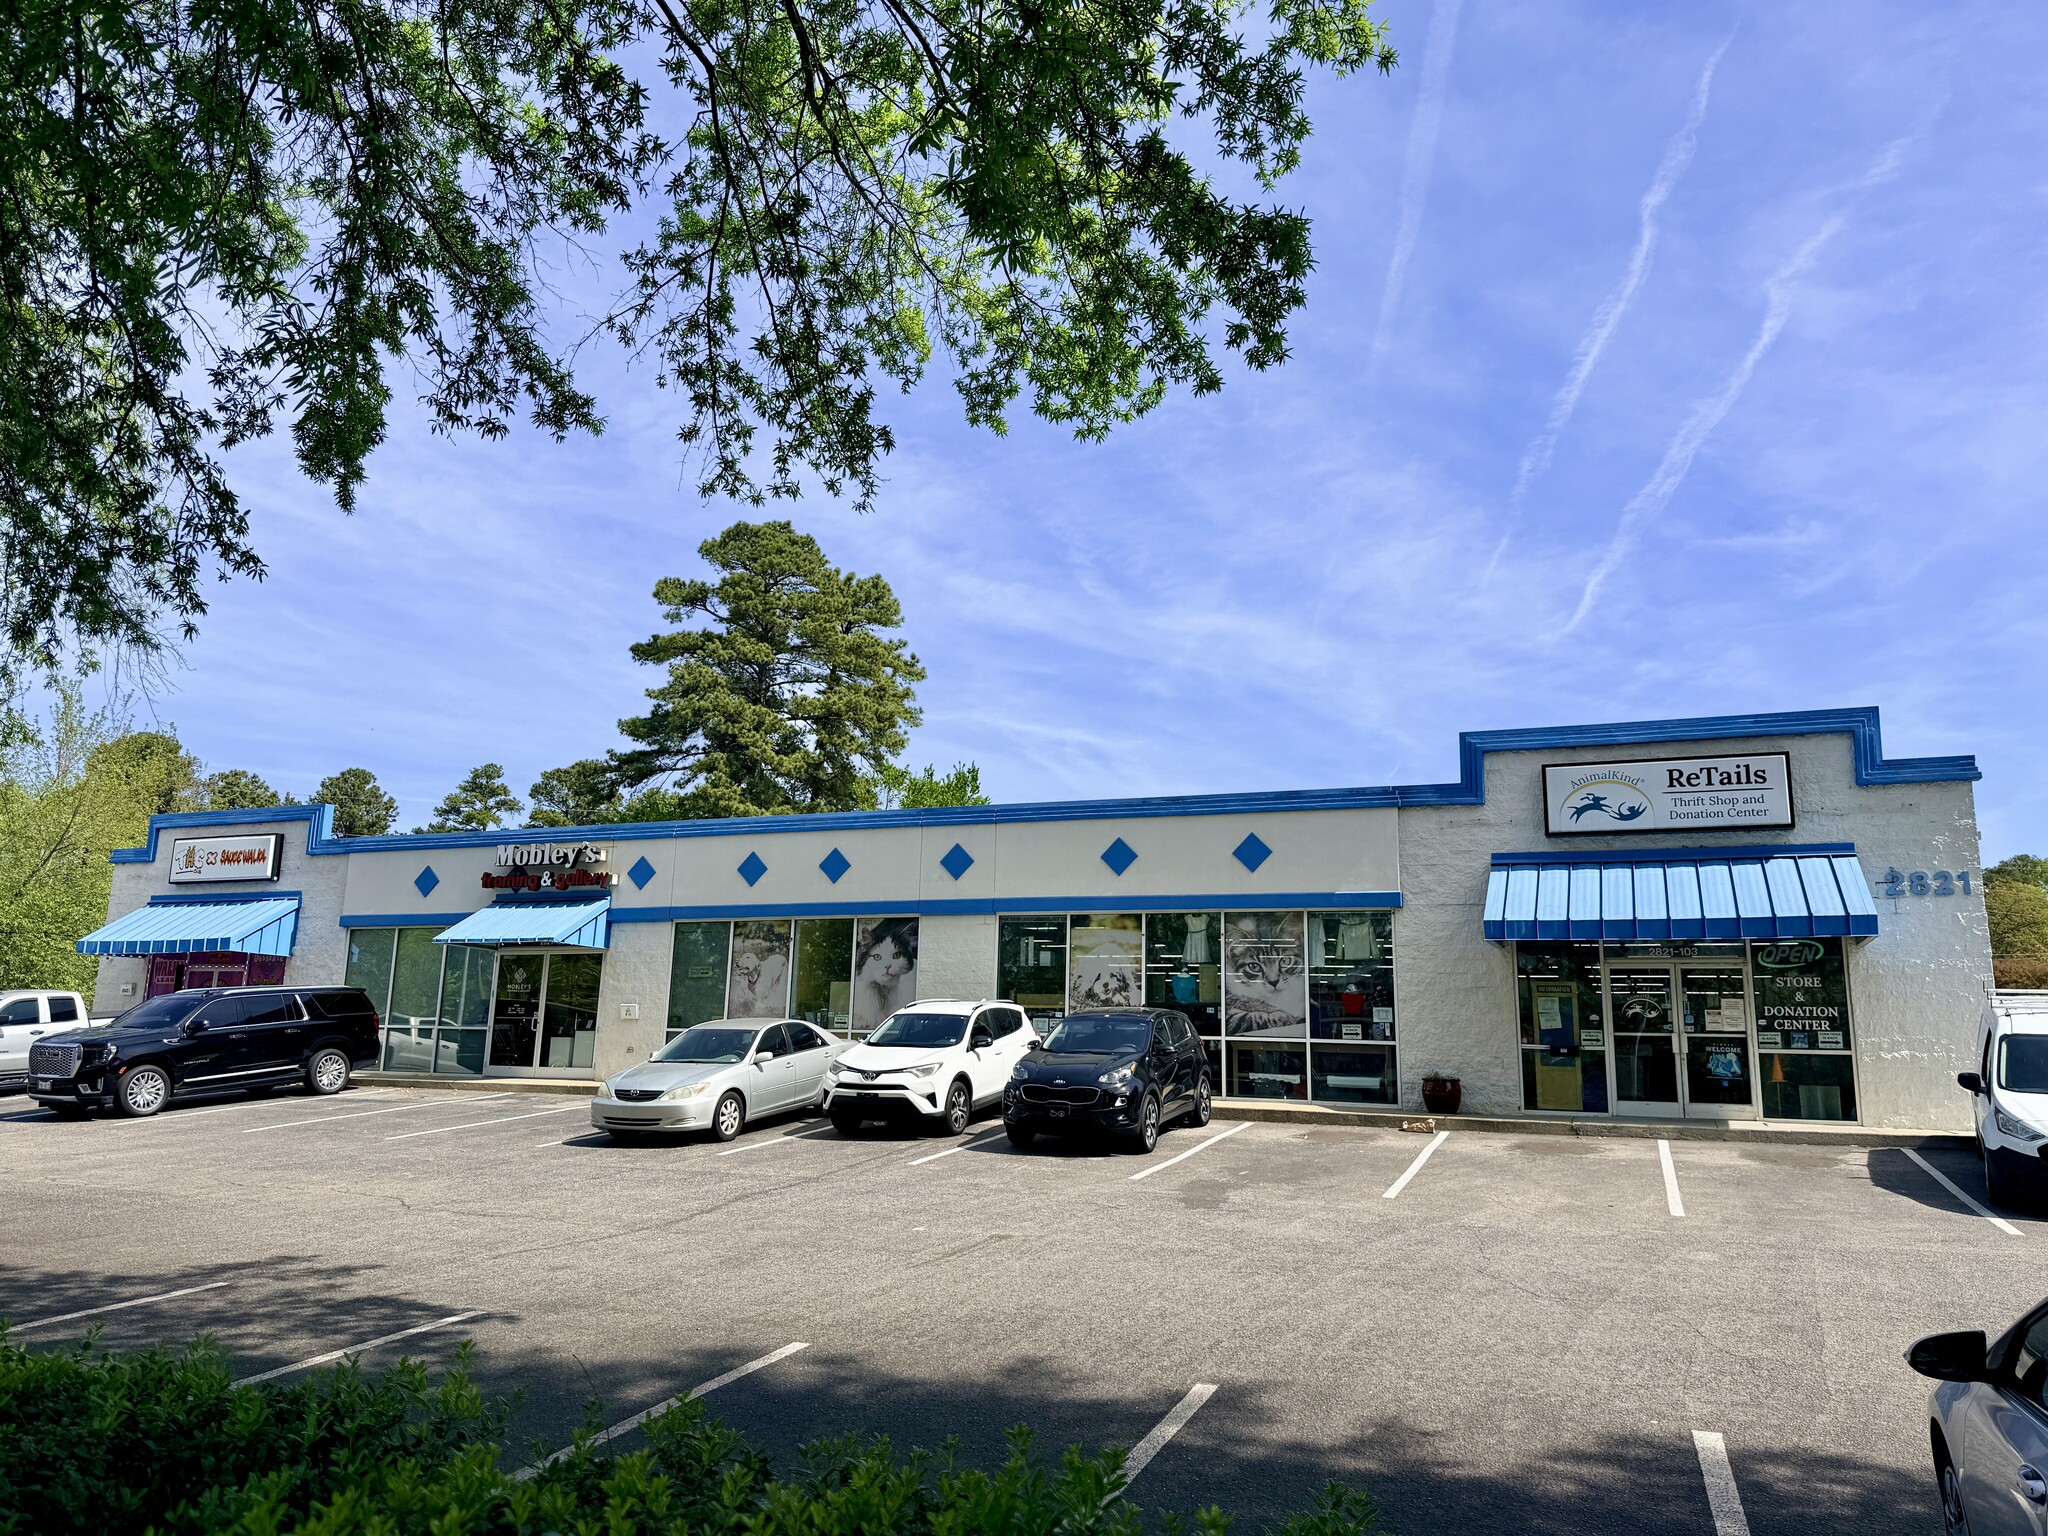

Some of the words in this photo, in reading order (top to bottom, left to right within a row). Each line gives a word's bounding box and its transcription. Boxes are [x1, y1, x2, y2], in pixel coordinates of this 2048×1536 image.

[1666, 763, 1768, 788] ReTails
[1671, 796, 1706, 807] Thrift
[1709, 795, 1739, 807] Shop
[1742, 794, 1765, 804] and
[1669, 809, 1724, 820] Donation
[1727, 808, 1769, 818] Center
[495, 841, 598, 868] Mobley's
[481, 872, 541, 891] framing
[541, 871, 552, 886] &
[555, 869, 610, 890] gallery
[1885, 870, 1971, 896] 2821
[1648, 947, 1698, 956] 2821-103
[1762, 945, 1817, 962] OPEN
[1776, 977, 1822, 987] STORE
[1795, 991, 1805, 1001] &
[1764, 1005, 1838, 1017] DONATION
[1774, 1019, 1830, 1030] CENTER
[1705, 1046, 1741, 1054] WELCOME
